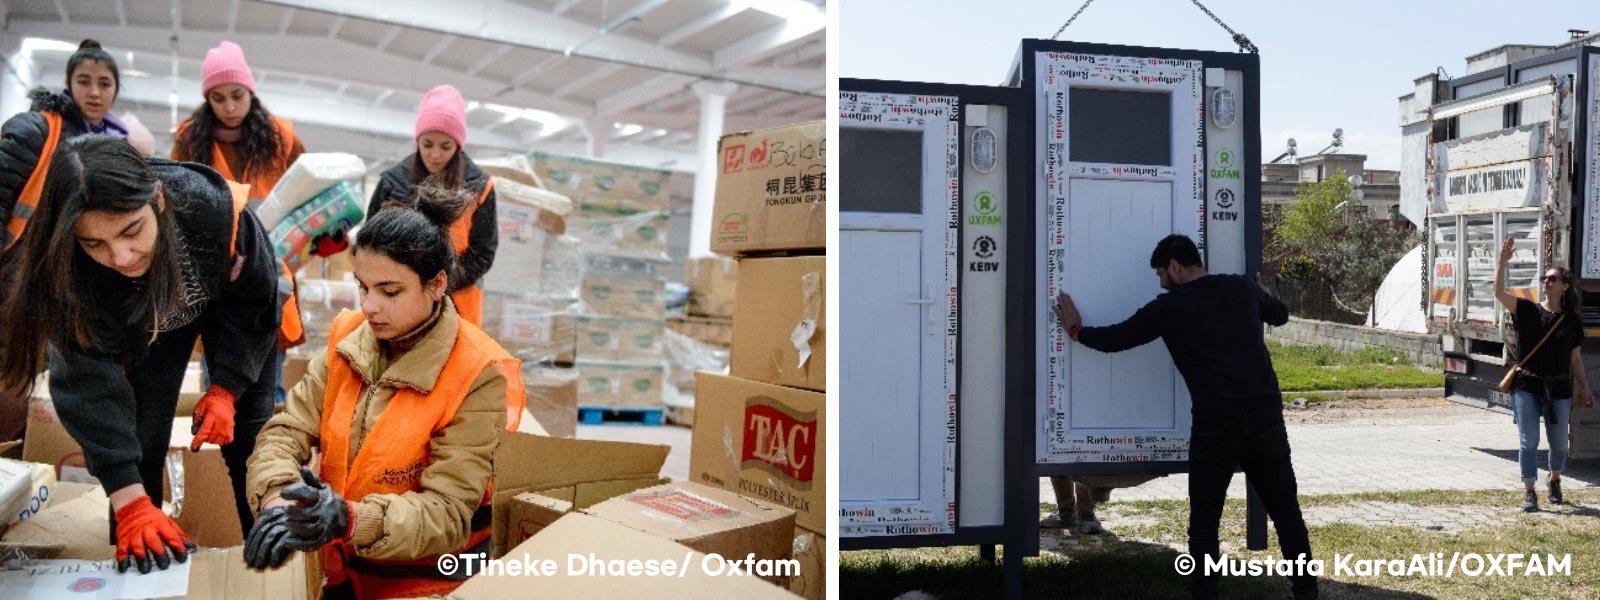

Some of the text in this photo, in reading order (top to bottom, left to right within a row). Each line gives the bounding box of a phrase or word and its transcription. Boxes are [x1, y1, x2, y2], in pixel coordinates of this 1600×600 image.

[1210, 169, 1240, 180] OXFAM
[765, 195, 802, 207] TONGKUN
[968, 214, 1001, 226] OXFAM
[969, 261, 1000, 272] KEDV
[749, 413, 810, 478] TAÇ
[738, 478, 785, 504] POLYESTER
